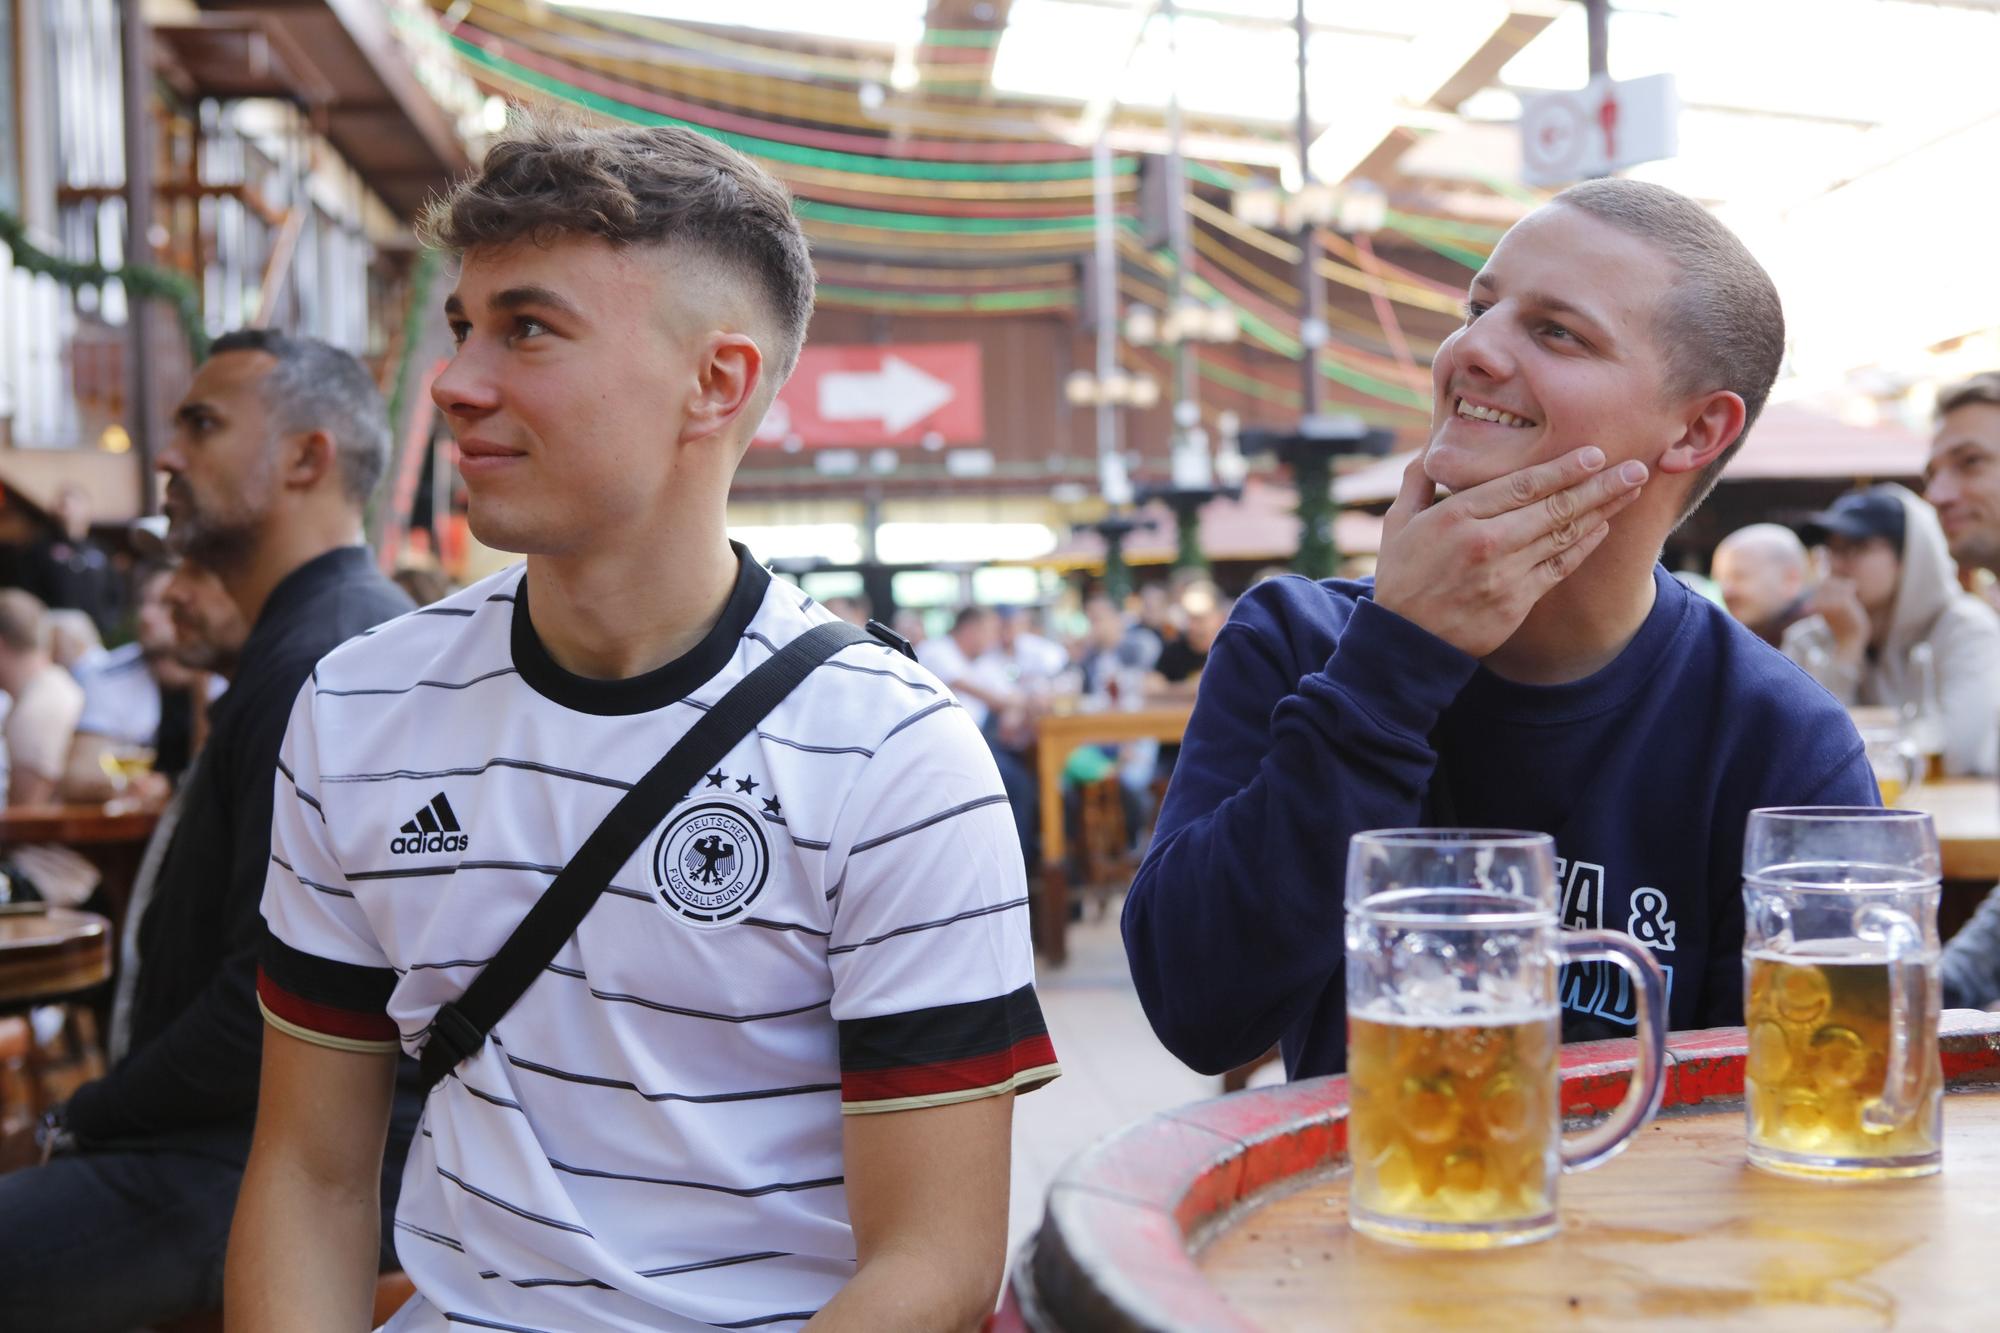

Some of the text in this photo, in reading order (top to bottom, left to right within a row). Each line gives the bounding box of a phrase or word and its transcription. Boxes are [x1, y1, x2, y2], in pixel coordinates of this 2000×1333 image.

[390, 831, 469, 854] adidas
[686, 817, 748, 843] DEUTSCHER
[669, 868, 745, 906] FUSSBALL-BUND
[1627, 887, 1676, 951] &
